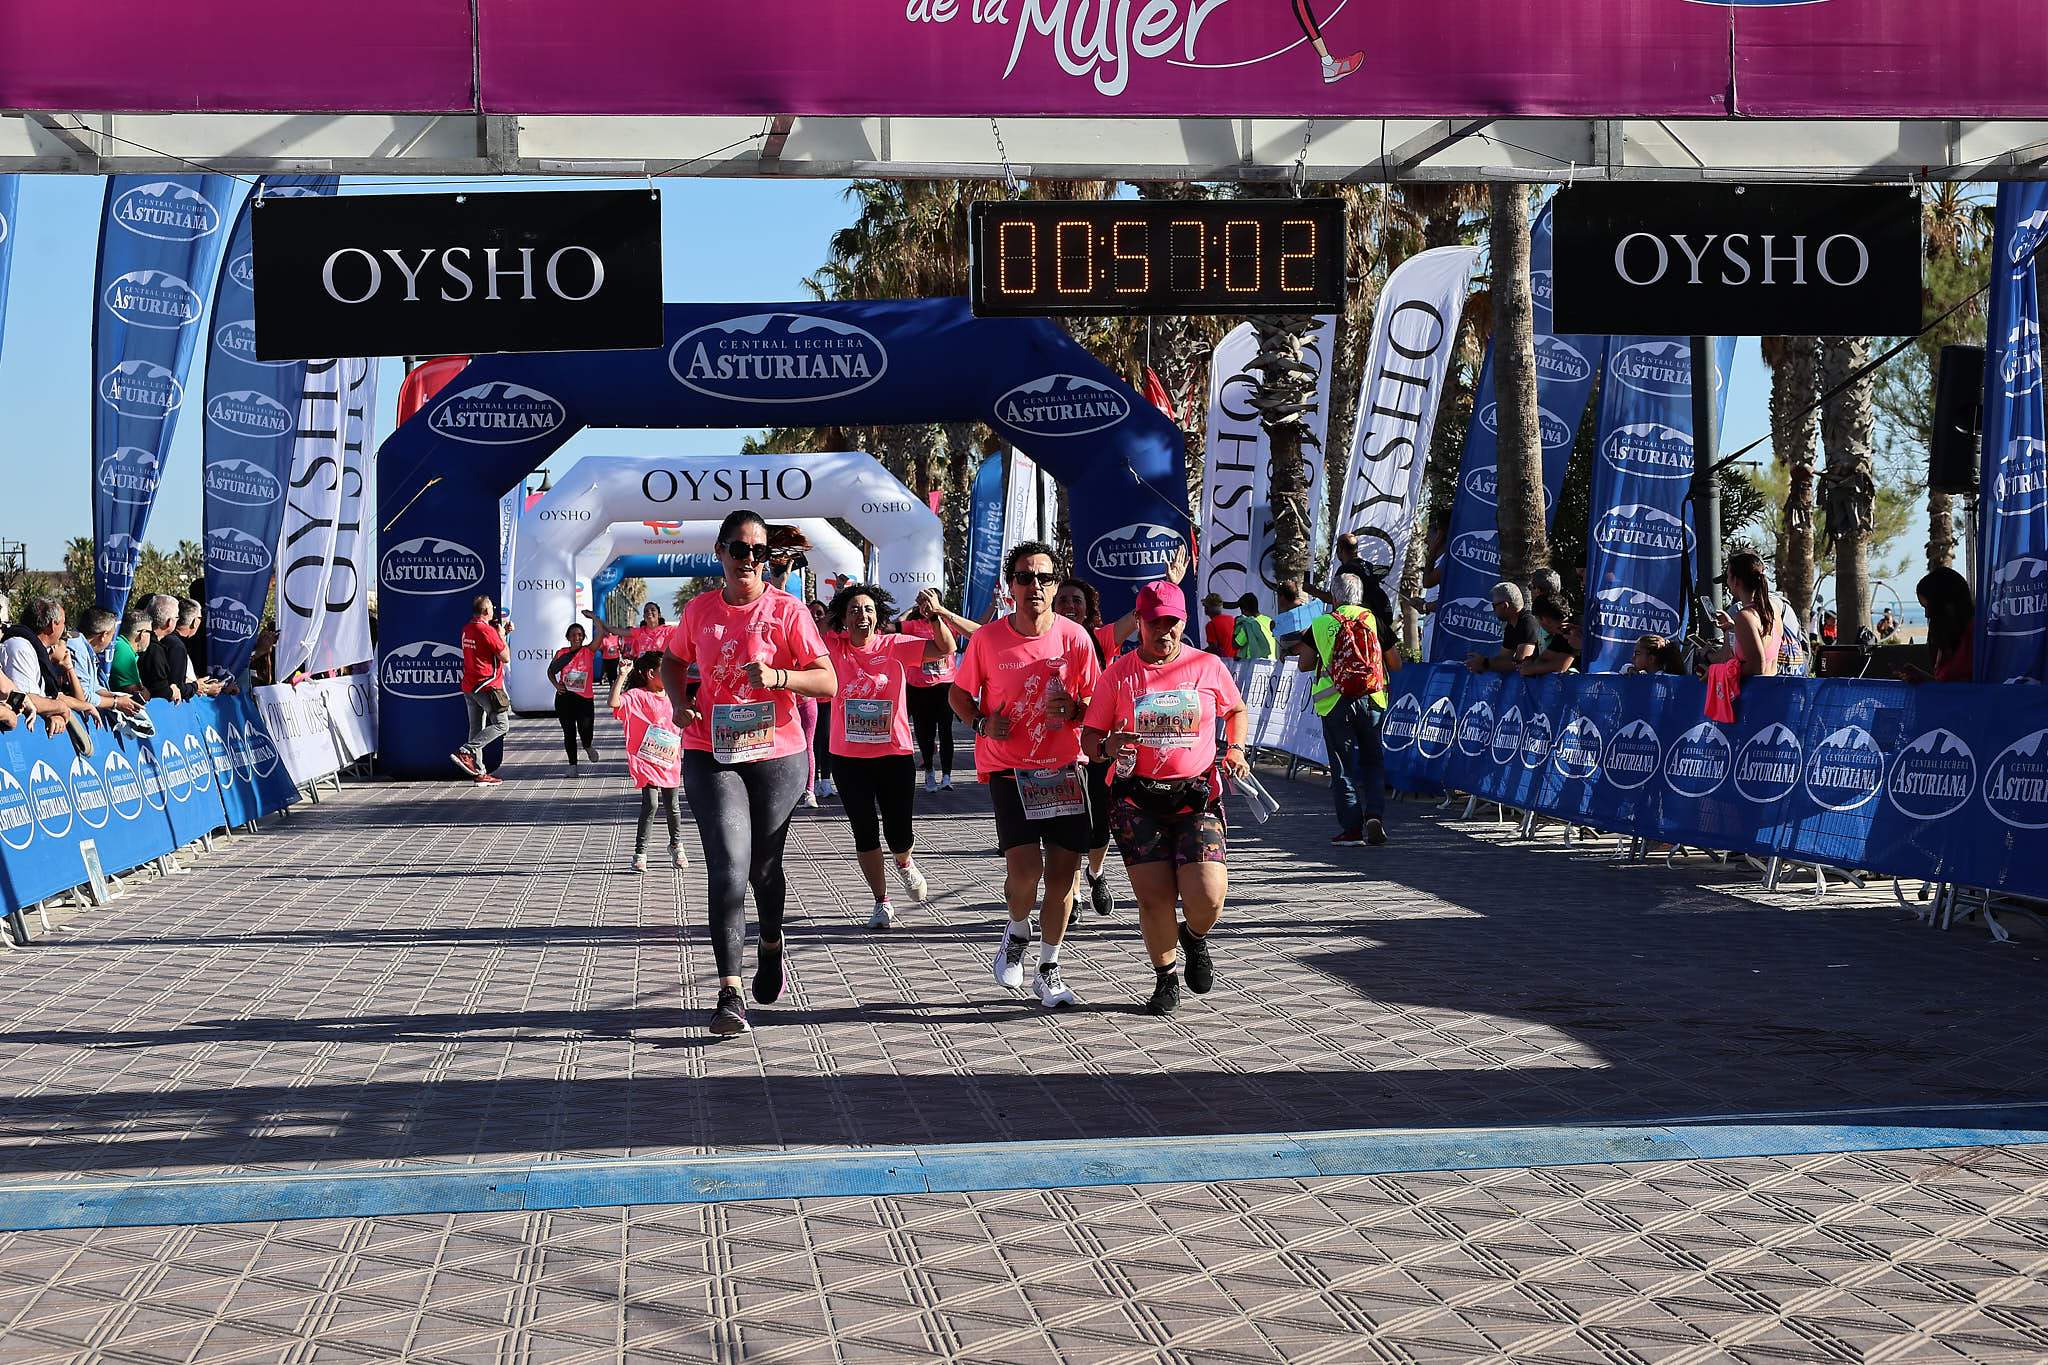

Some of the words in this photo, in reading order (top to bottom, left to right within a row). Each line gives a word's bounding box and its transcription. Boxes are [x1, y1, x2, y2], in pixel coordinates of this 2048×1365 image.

[120, 198, 208, 231] ASTURIANA
[138, 198, 173, 209] CENTRAL
[1000, 220, 1316, 294] 00:57:02
[1614, 232, 1870, 286] OYSHO
[322, 245, 605, 304] OYSHO
[719, 339, 787, 349] CENTRAL
[795, 338, 864, 349] LECHERA
[686, 341, 872, 380] ASTURIANA
[1536, 354, 1582, 378] URIANA
[1618, 354, 1693, 385] ASTURIA
[1635, 355, 1673, 367] CENTRAL
[458, 401, 503, 410] CENTRAL
[506, 403, 552, 411] LECHERA
[1023, 394, 1067, 404] CENTRAL
[1072, 391, 1115, 400] LECHERA
[212, 401, 286, 431] ASTURIANA
[436, 405, 555, 429] ASTURIANA
[1006, 400, 1123, 423] ASTURIANA
[1609, 437, 1695, 469] ASTURIAN
[1662, 443, 1694, 453] LECHE
[206, 470, 275, 499] ASTURIANA
[641, 466, 813, 503] OYSHO
[539, 509, 591, 521] OYSHO
[861, 501, 912, 514] OYSHO
[975, 501, 1002, 577] Marlene
[1109, 542, 1147, 551] CENTRAL
[1150, 540, 1180, 548] LECHER
[208, 546, 264, 568] STURIAN
[436, 556, 475, 564] LECHERA
[1094, 546, 1179, 568] ASTURIAN
[1455, 539, 1501, 566] ASTURI
[385, 559, 478, 581] ASTURIANA
[889, 572, 936, 584] OYSHO
[517, 578, 566, 592] OYSHO
[396, 660, 432, 668] CENTRAL
[435, 660, 464, 668] LECHE
[517, 648, 555, 661] OYSH
[998, 661, 1026, 670] OYSHO
[385, 662, 464, 684] ASTURIAN
[1607, 743, 1654, 773] ASTURIANA
[1668, 752, 1725, 780] ASTURIANA
[1737, 751, 1796, 784] ASTURIANA
[1910, 758, 1938, 769] CENTRAL
[1940, 759, 1969, 770] LECHERA
[1808, 754, 1876, 791] ASTURIANA
[1892, 760, 1967, 798] ASTURIANA
[1988, 763, 2048, 803] ASTUR
